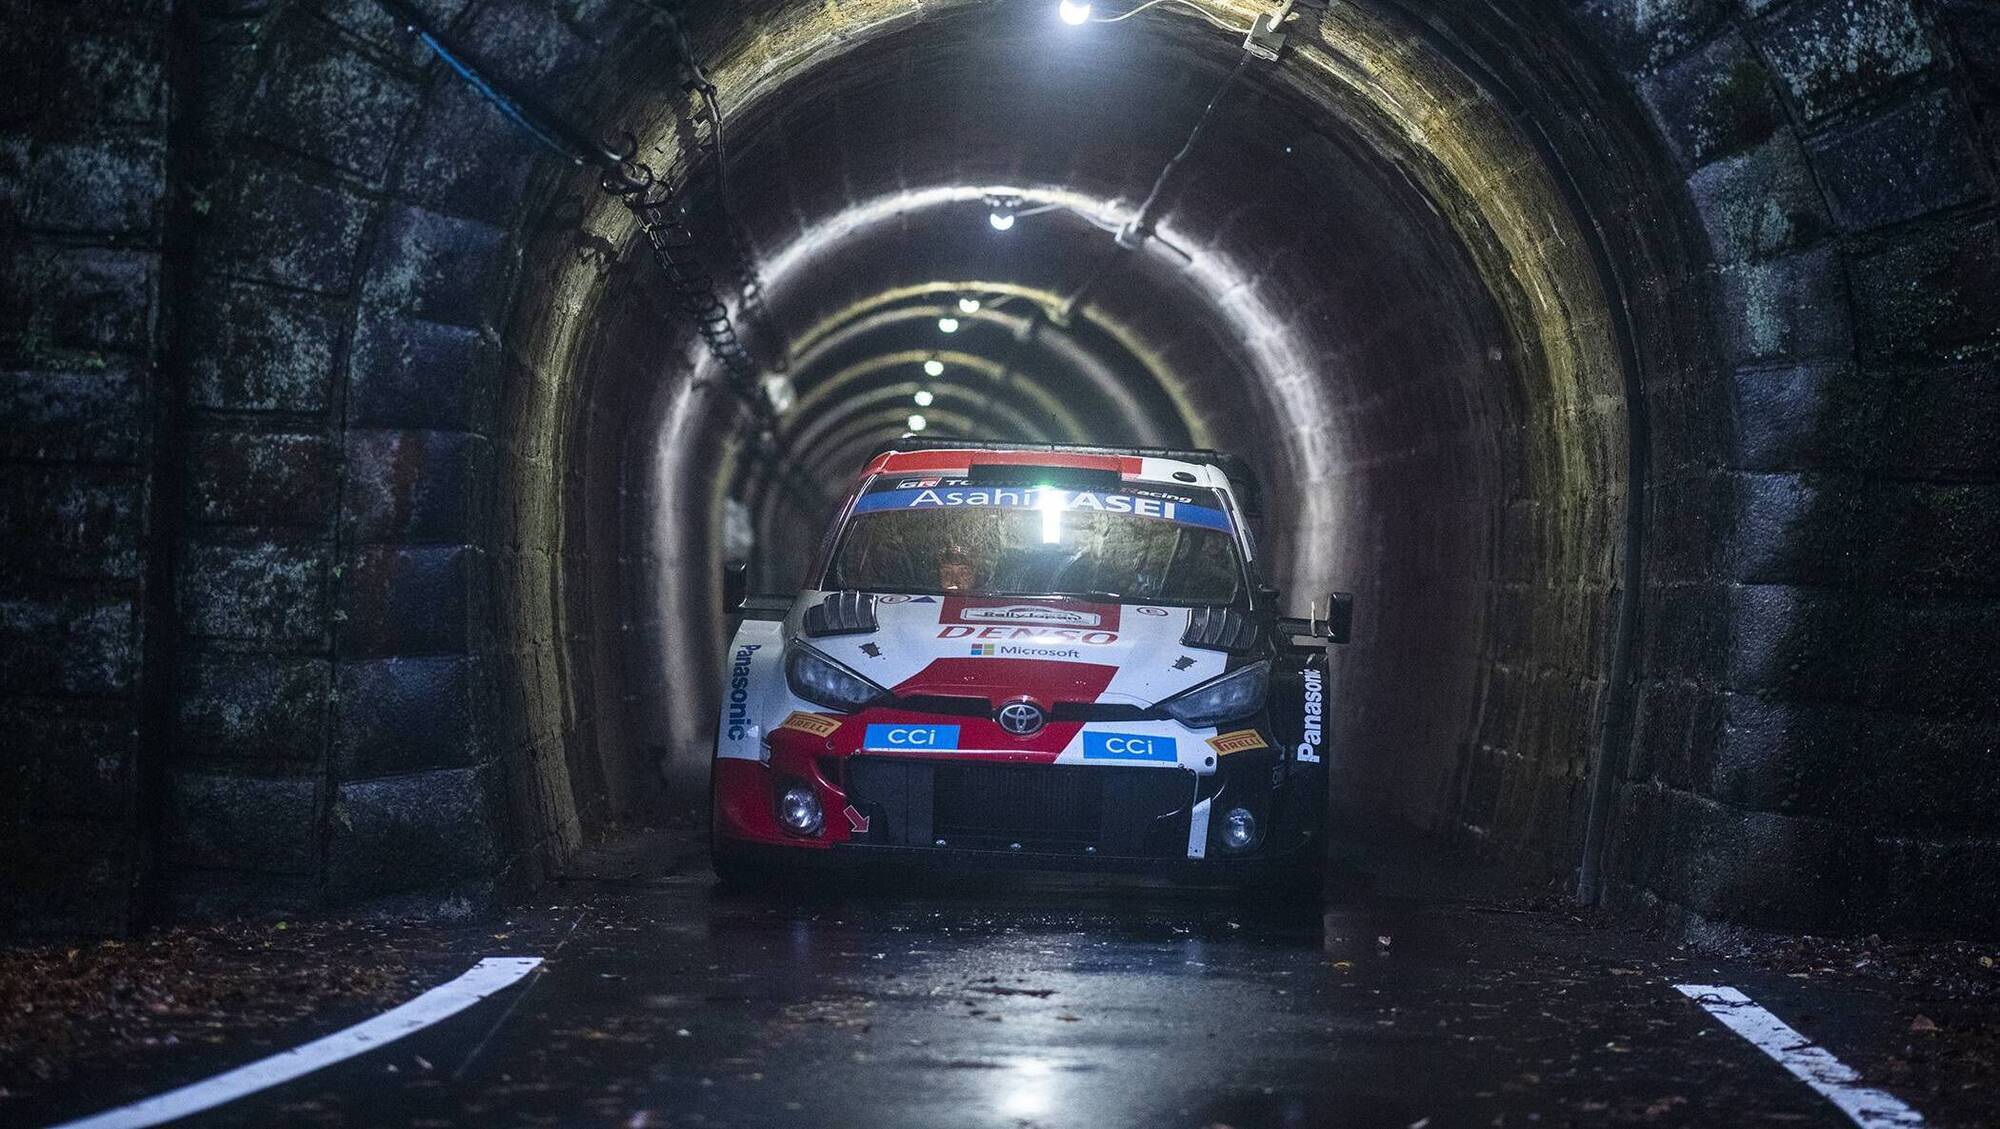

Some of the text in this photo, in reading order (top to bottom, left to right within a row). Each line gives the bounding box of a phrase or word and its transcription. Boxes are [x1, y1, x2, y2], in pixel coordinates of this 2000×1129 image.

[909, 489, 1175, 519] Asahi ASEI
[1000, 646, 1081, 659] Microsoft
[728, 644, 762, 741] Panasonic
[1212, 733, 1262, 752] PIRELLI
